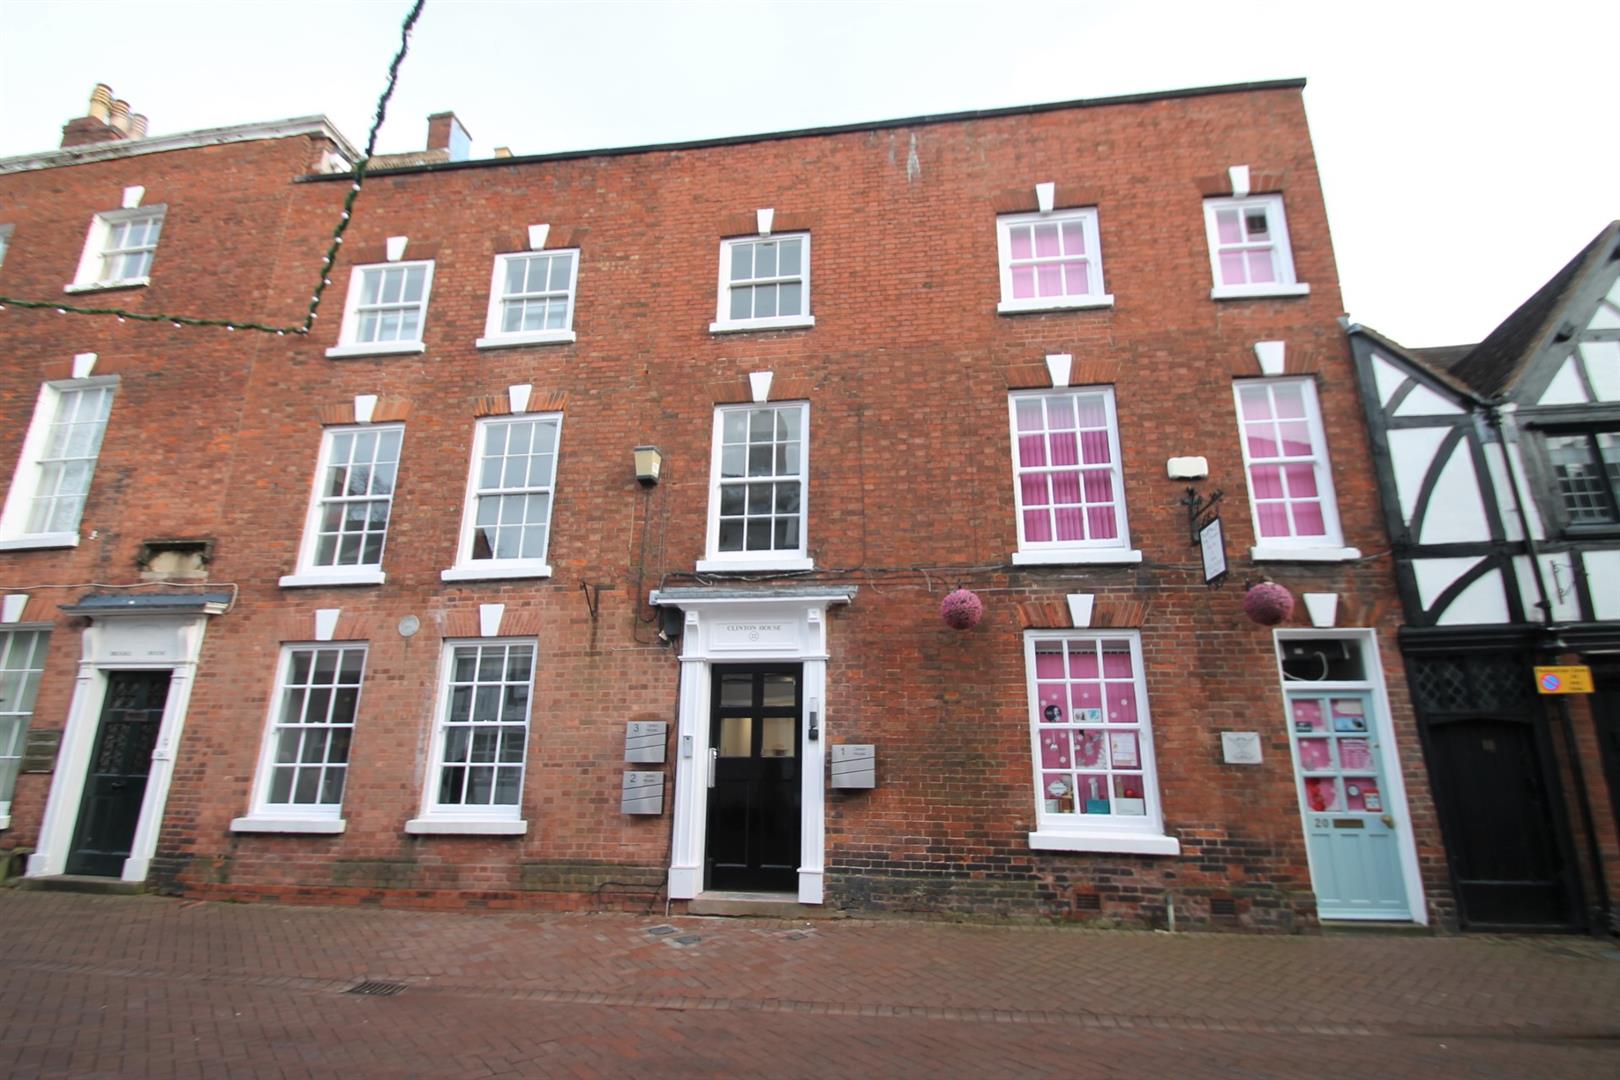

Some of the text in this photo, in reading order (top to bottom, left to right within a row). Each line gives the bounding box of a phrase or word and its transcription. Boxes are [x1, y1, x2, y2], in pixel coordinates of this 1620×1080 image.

[633, 724, 640, 732] 3
[630, 773, 637, 783] 2
[1314, 817, 1329, 829] 20
